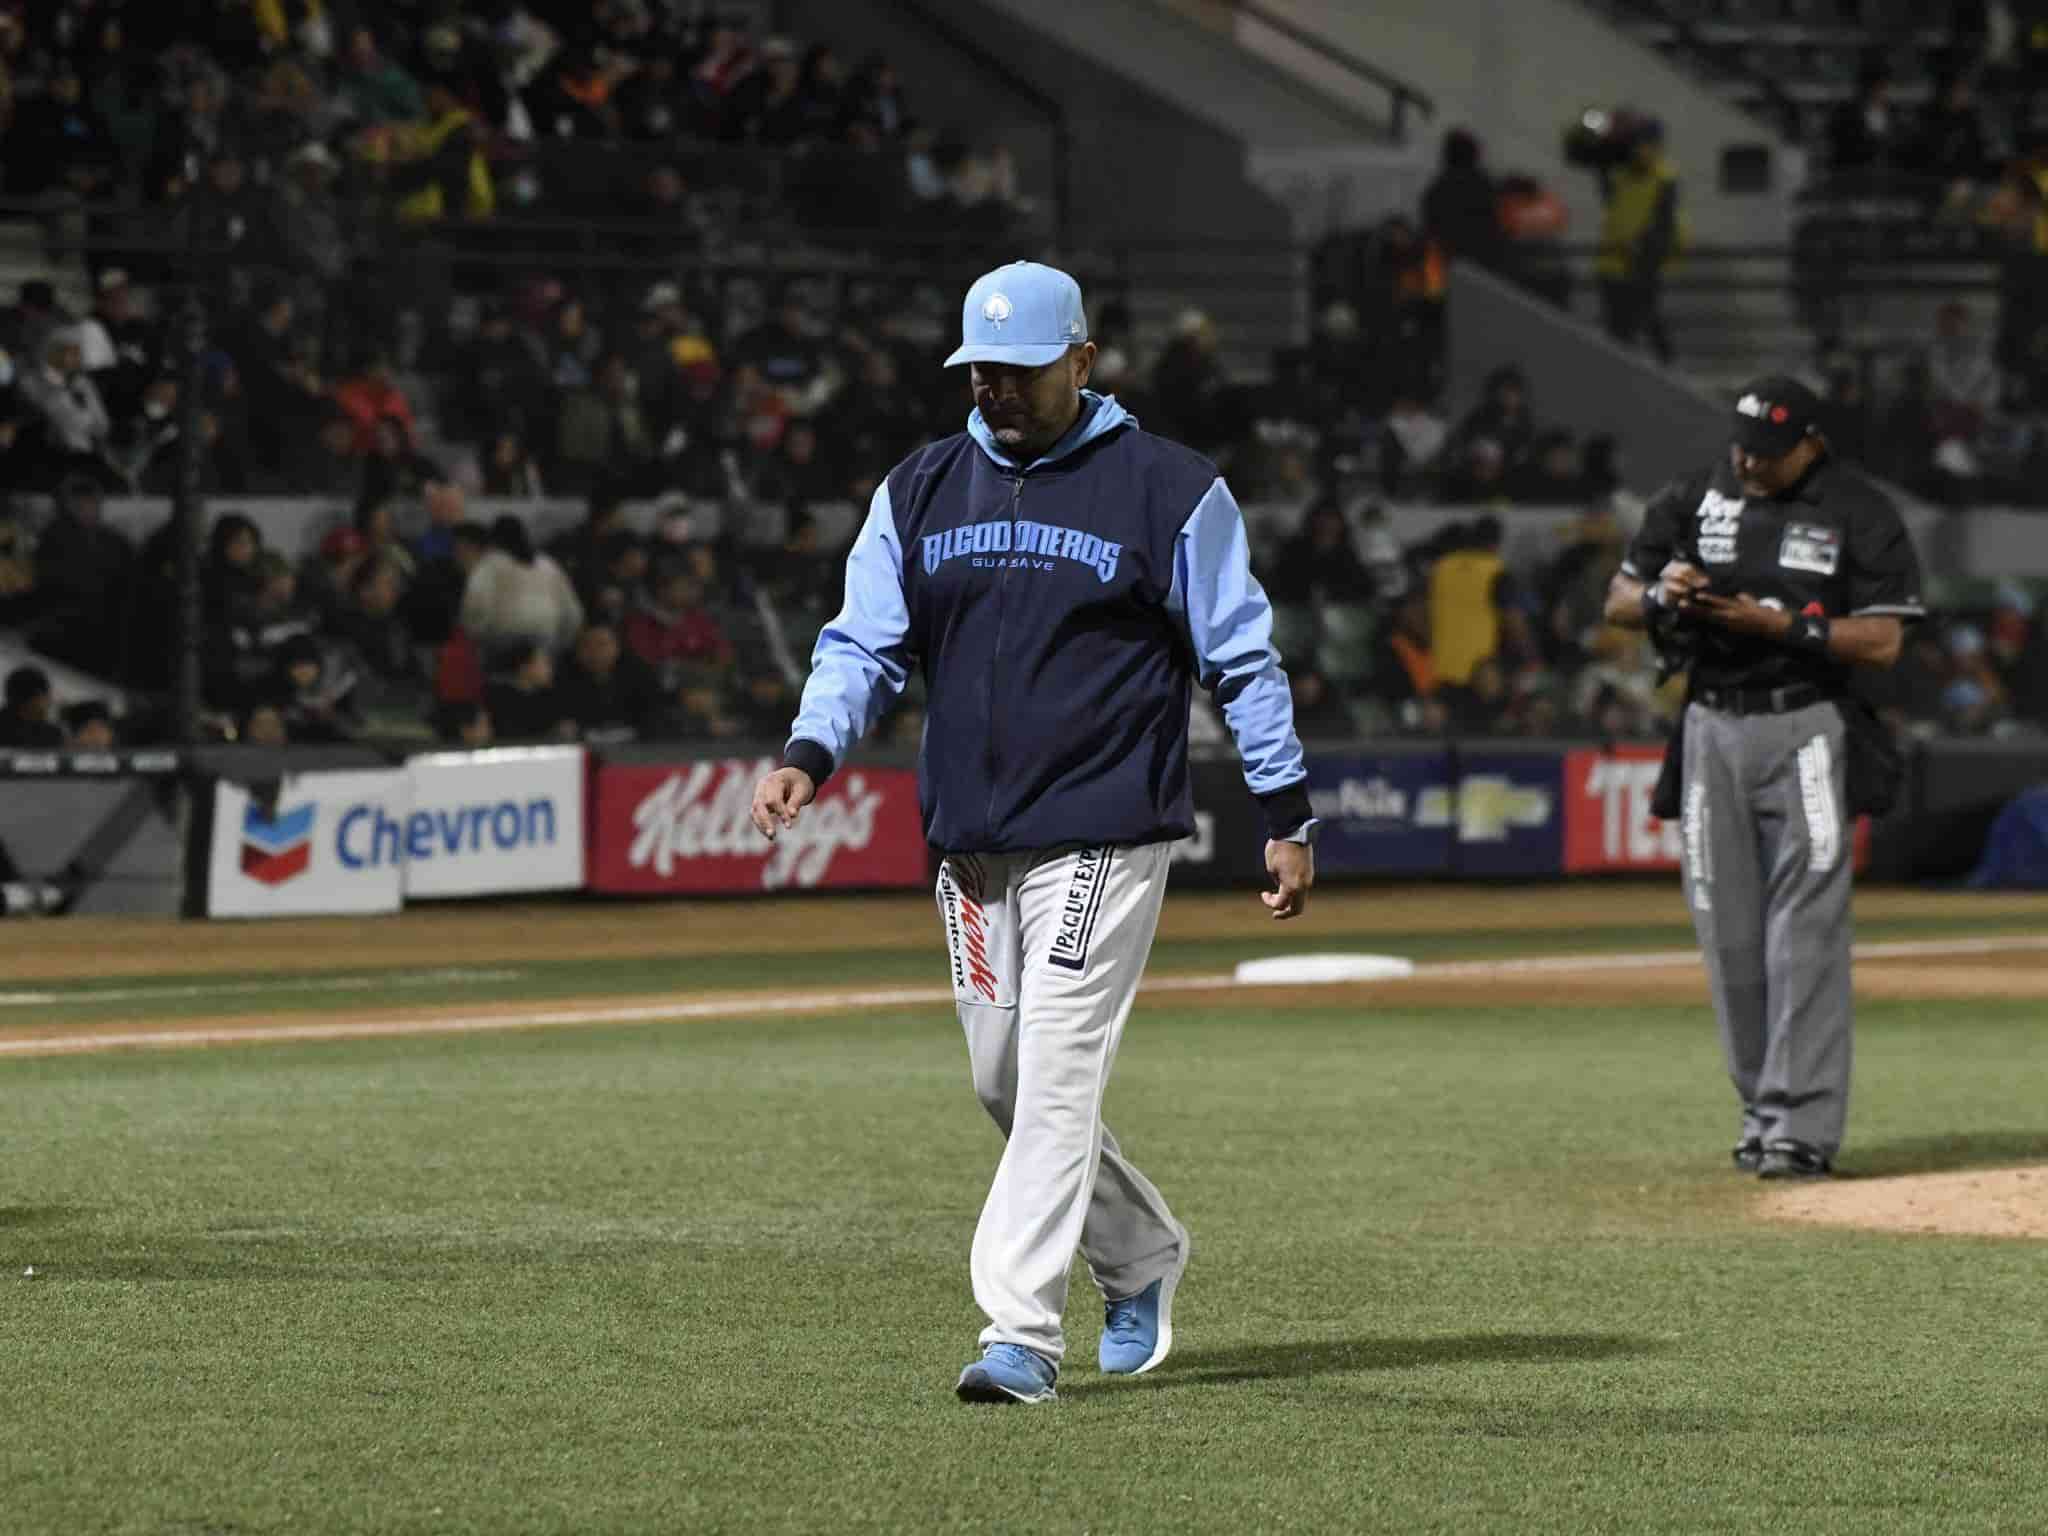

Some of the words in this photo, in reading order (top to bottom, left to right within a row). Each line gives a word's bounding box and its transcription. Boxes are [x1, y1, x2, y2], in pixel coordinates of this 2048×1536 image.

[921, 520, 1125, 584] ALGODONEROS
[972, 557, 1057, 572] GUASAVE
[334, 796, 558, 870] Chevron
[628, 756, 882, 890] Kellgg's
[940, 866, 966, 989] caliente.mx
